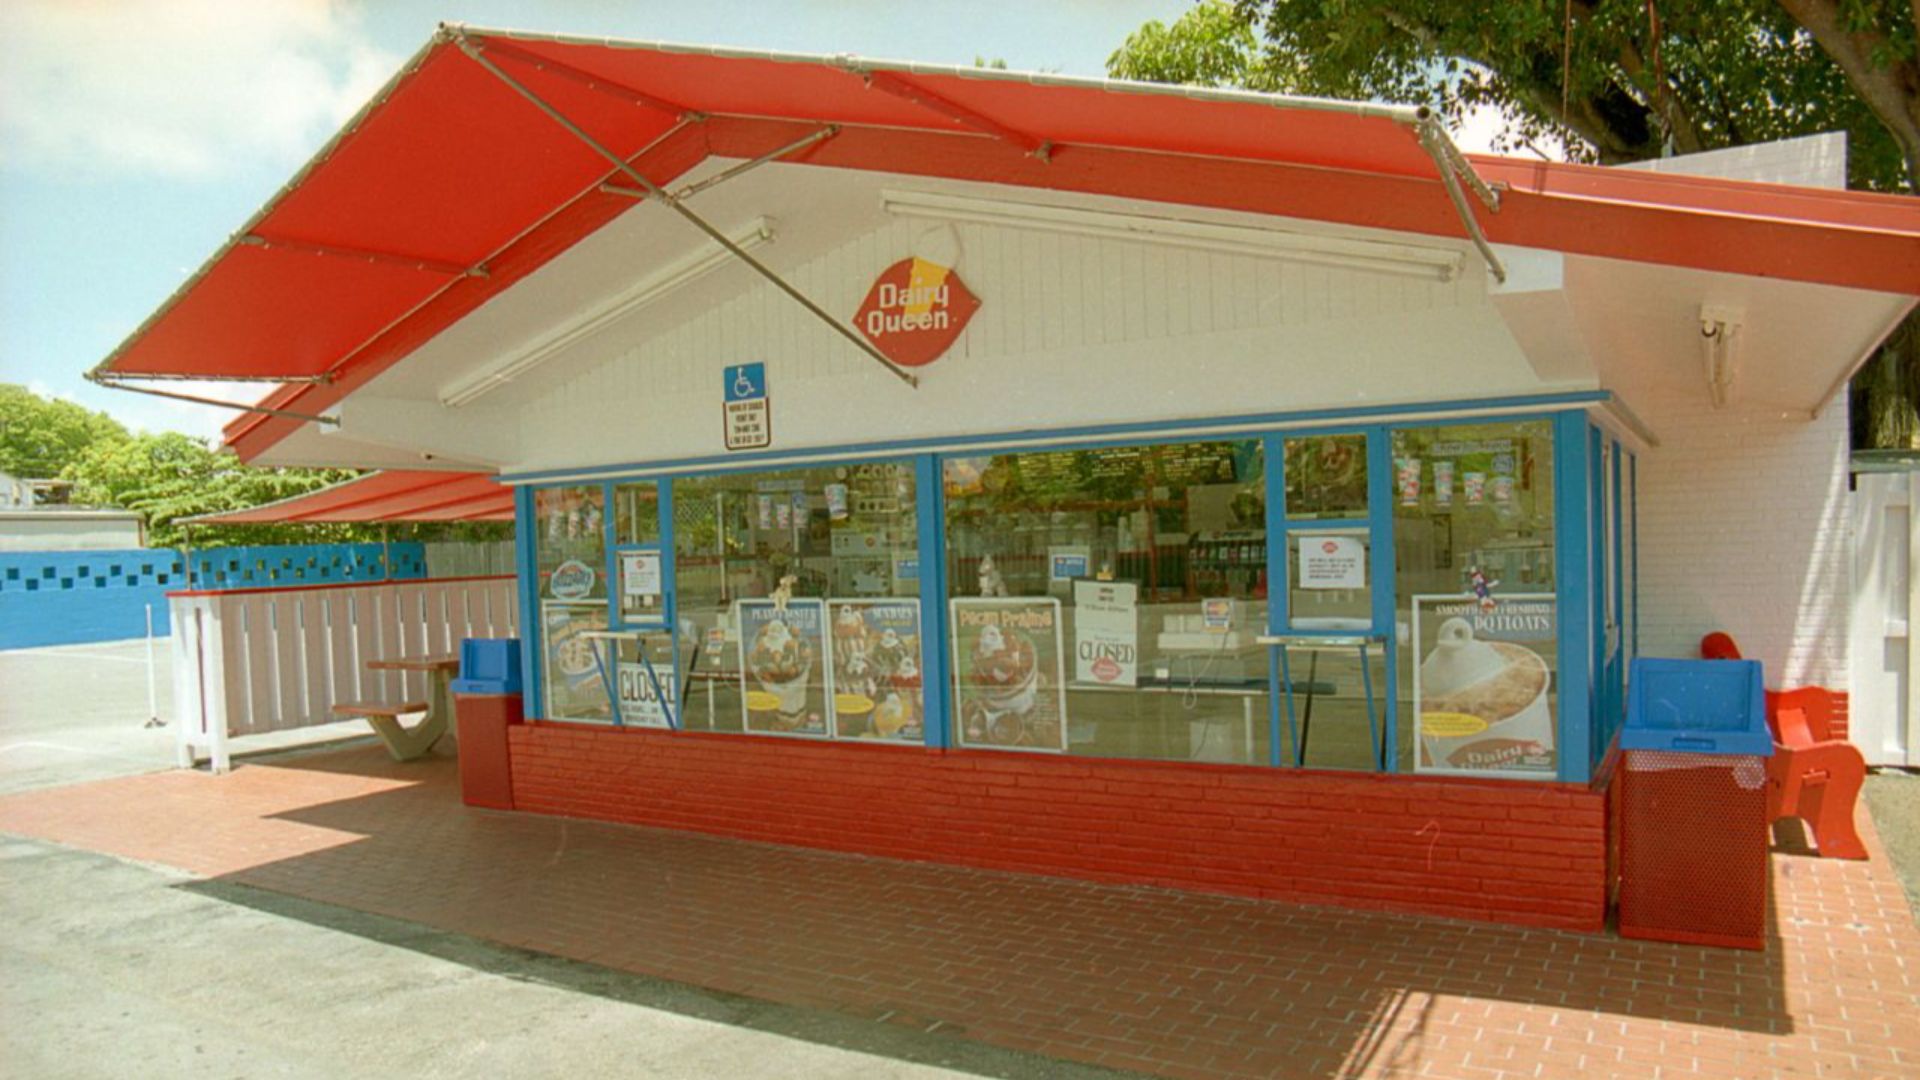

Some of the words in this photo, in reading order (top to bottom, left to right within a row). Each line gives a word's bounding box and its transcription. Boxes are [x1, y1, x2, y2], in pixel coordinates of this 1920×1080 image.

[879, 278, 949, 309] Dairy
[867, 310, 949, 338] Queen
[1079, 640, 1136, 664] CLOSED
[620, 670, 675, 704] CLOSED
